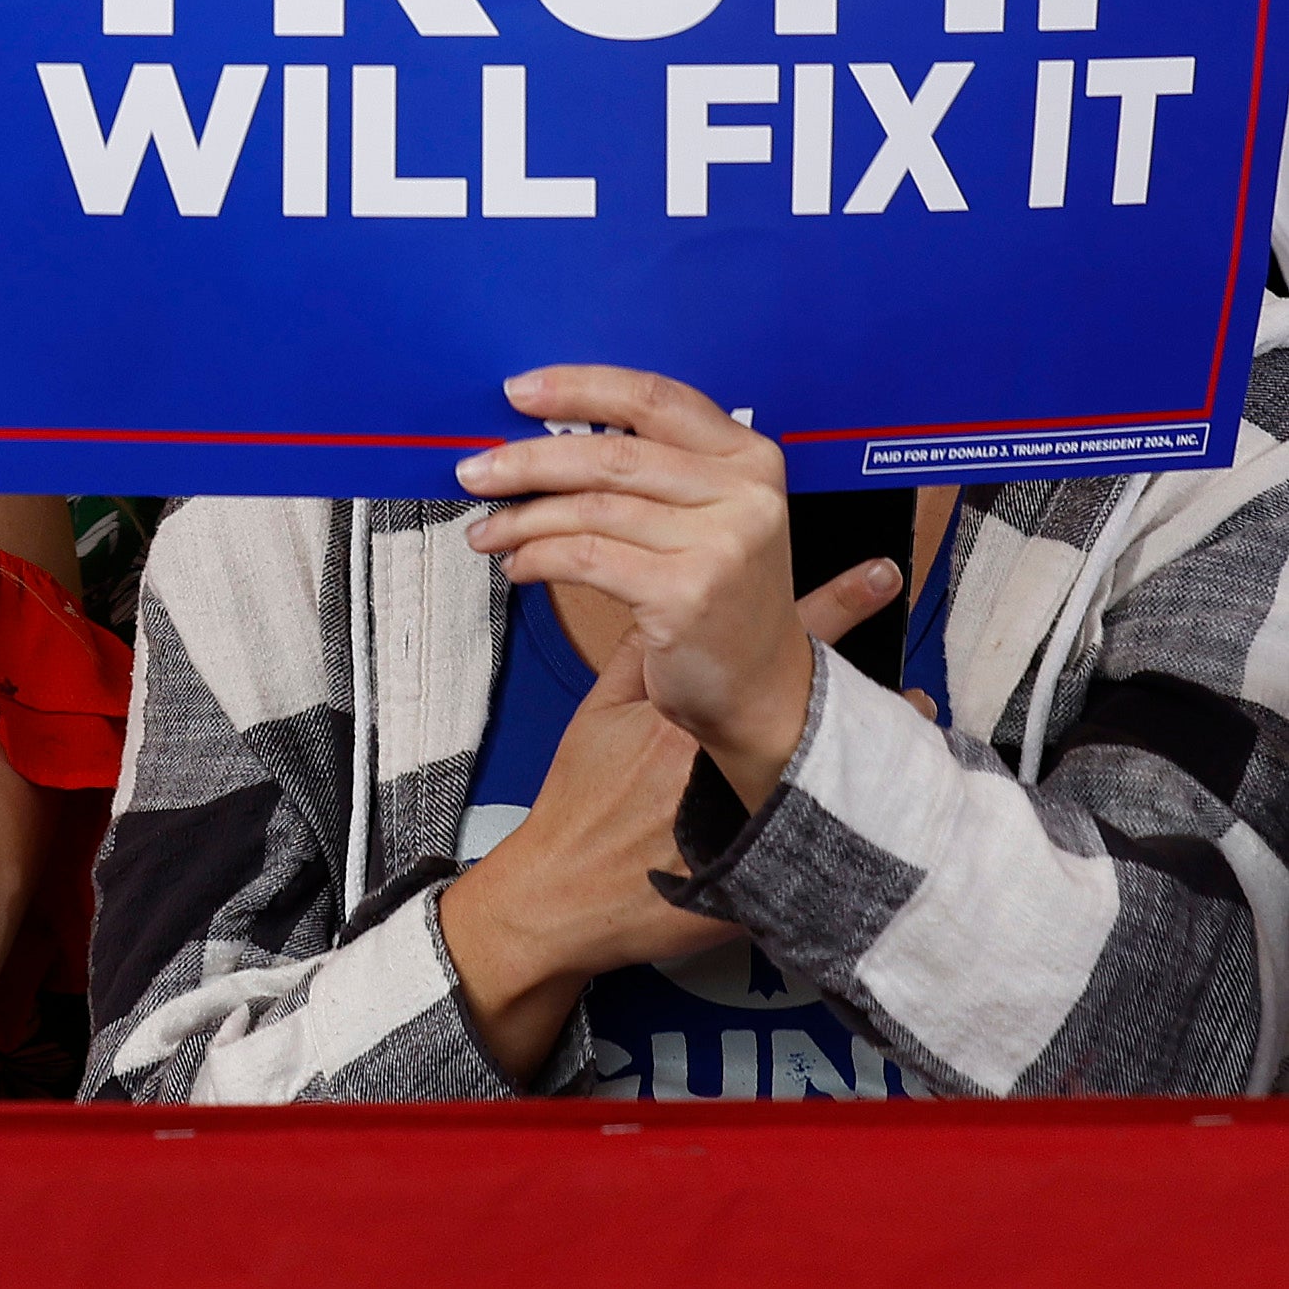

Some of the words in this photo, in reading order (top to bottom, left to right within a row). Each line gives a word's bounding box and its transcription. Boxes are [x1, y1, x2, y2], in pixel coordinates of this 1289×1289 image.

[36, 63, 596, 218] WILL
[666, 61, 975, 217] FIX
[1028, 56, 1196, 209] IT
[873, 450, 902, 464] PAID
[903, 448, 928, 462] FOR
[930, 448, 947, 461] BY
[948, 445, 999, 460] DONALD
[999, 444, 1010, 458] J.
[1012, 442, 1053, 456] TRUMP
[1054, 440, 1079, 455] FOR
[1080, 436, 1143, 453] PRESIDENT
[1144, 434, 1174, 449] 2024,
[1176, 433, 1199, 447] INC.
